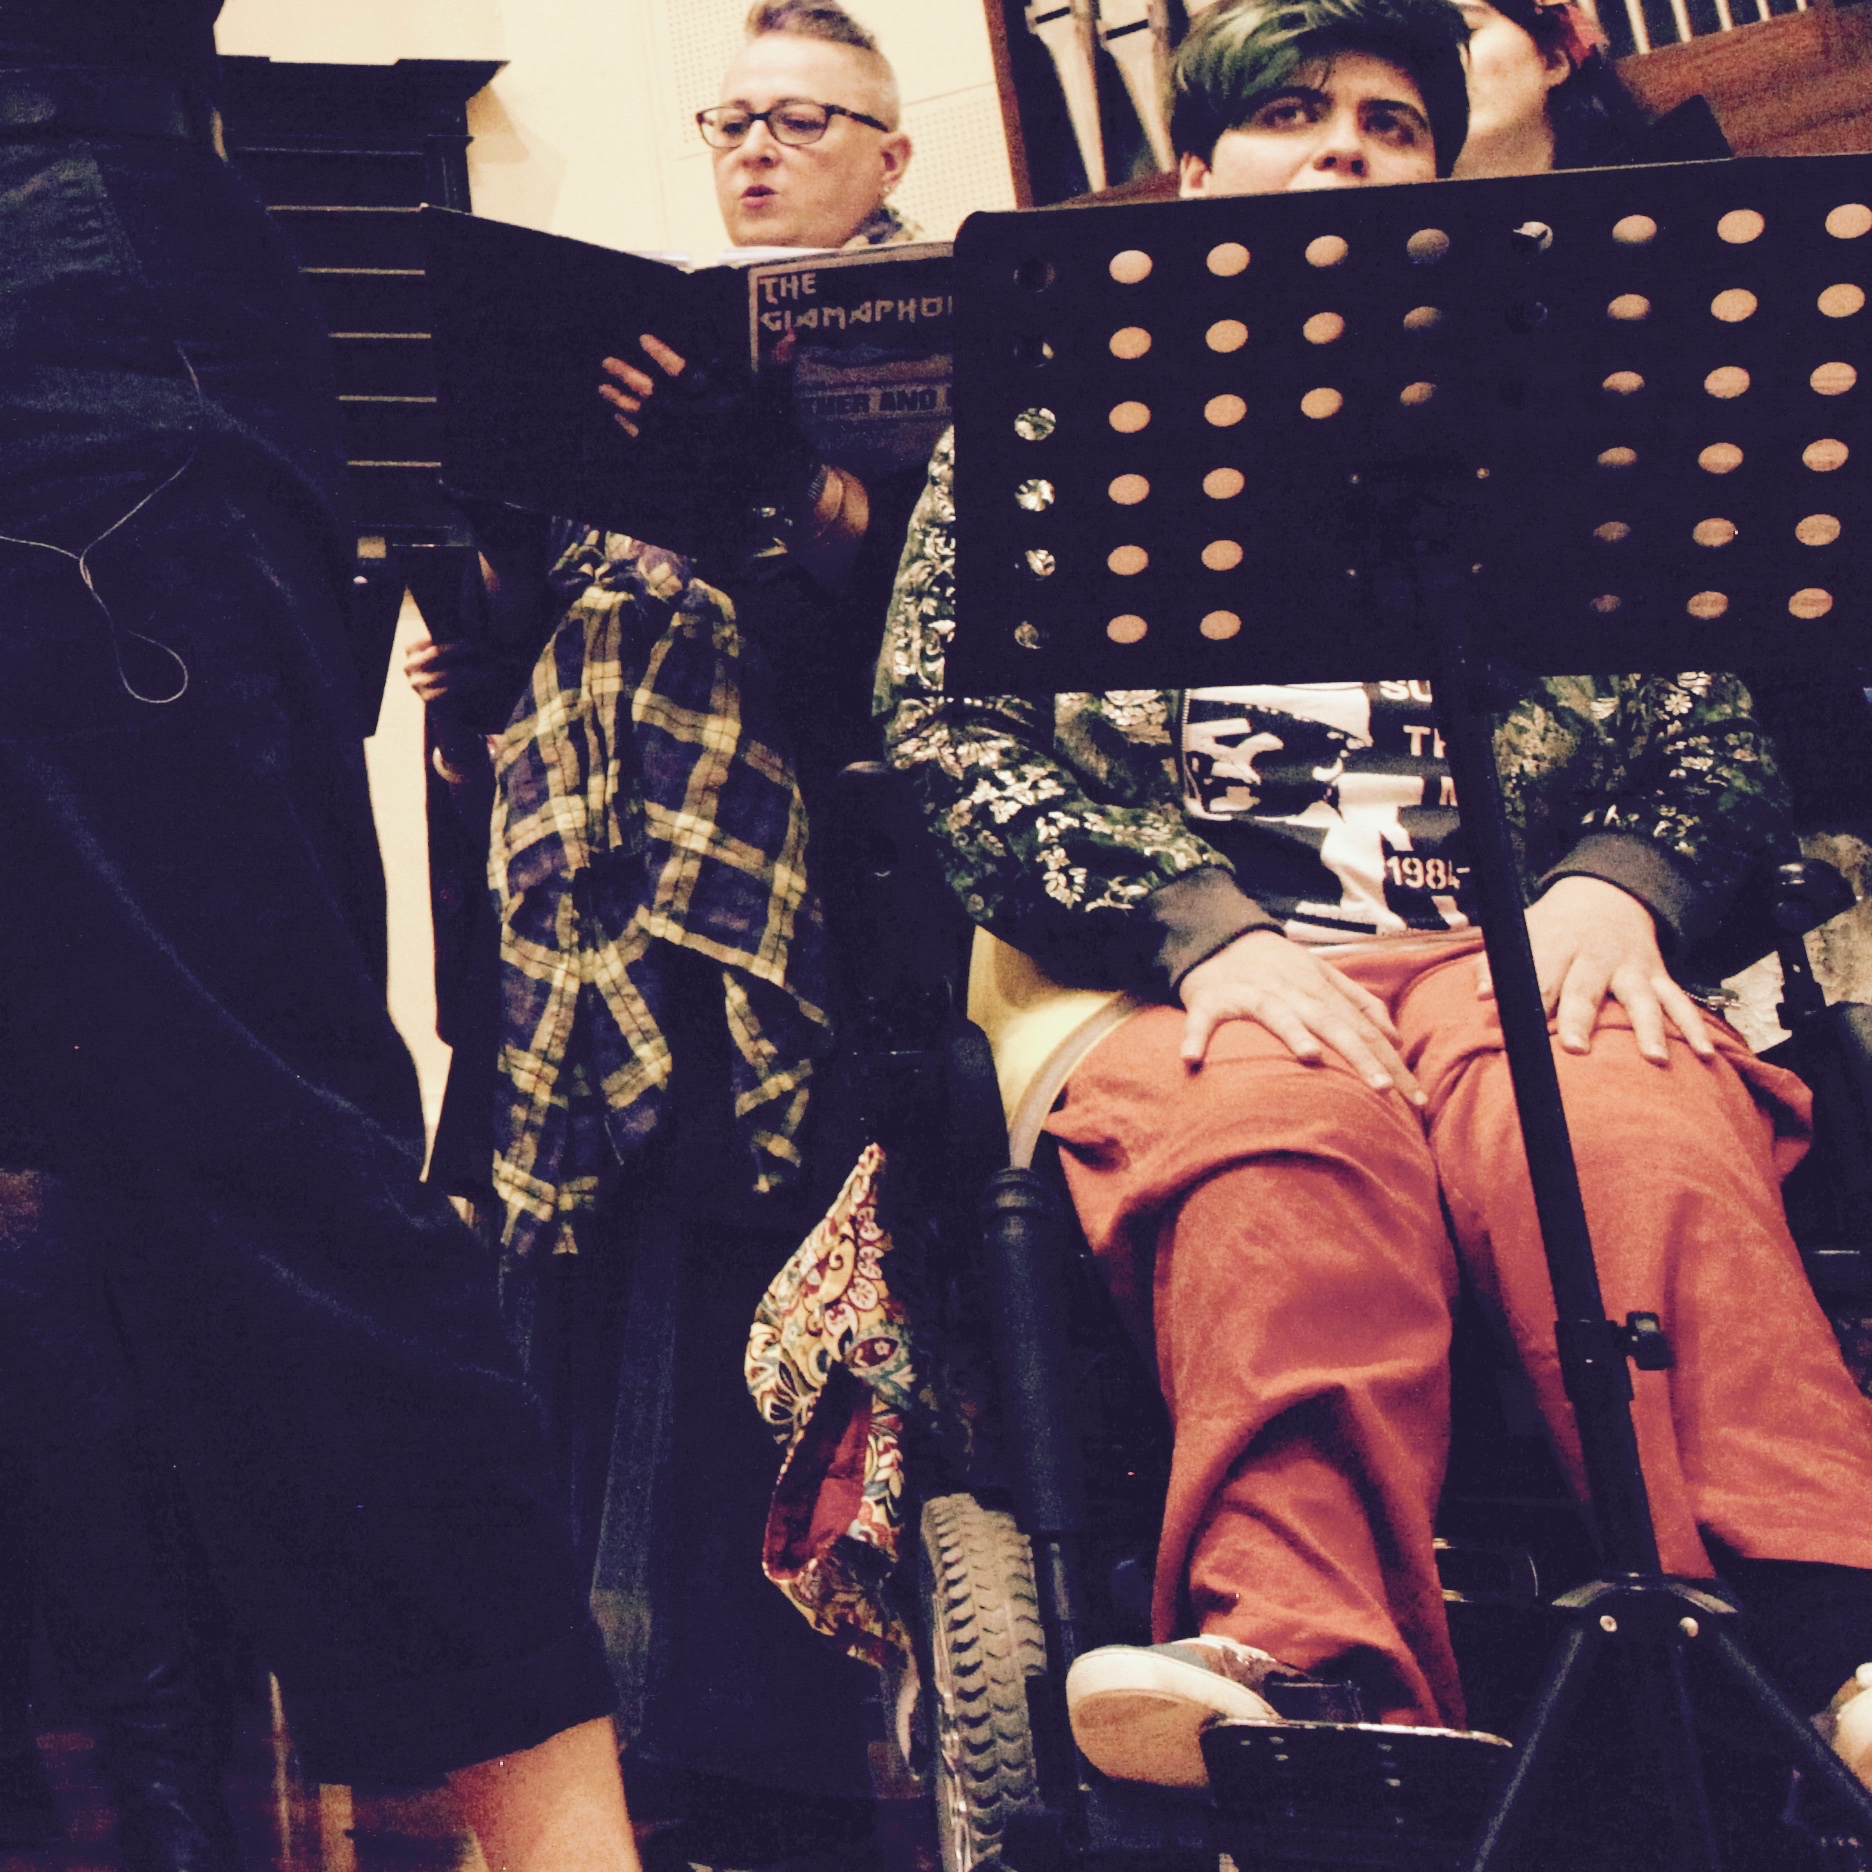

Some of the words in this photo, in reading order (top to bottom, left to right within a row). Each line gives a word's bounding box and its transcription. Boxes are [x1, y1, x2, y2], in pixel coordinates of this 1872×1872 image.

[758, 272, 818, 304] THE
[758, 295, 953, 332] GLAMAPHO
[878, 388, 938, 413] AND
